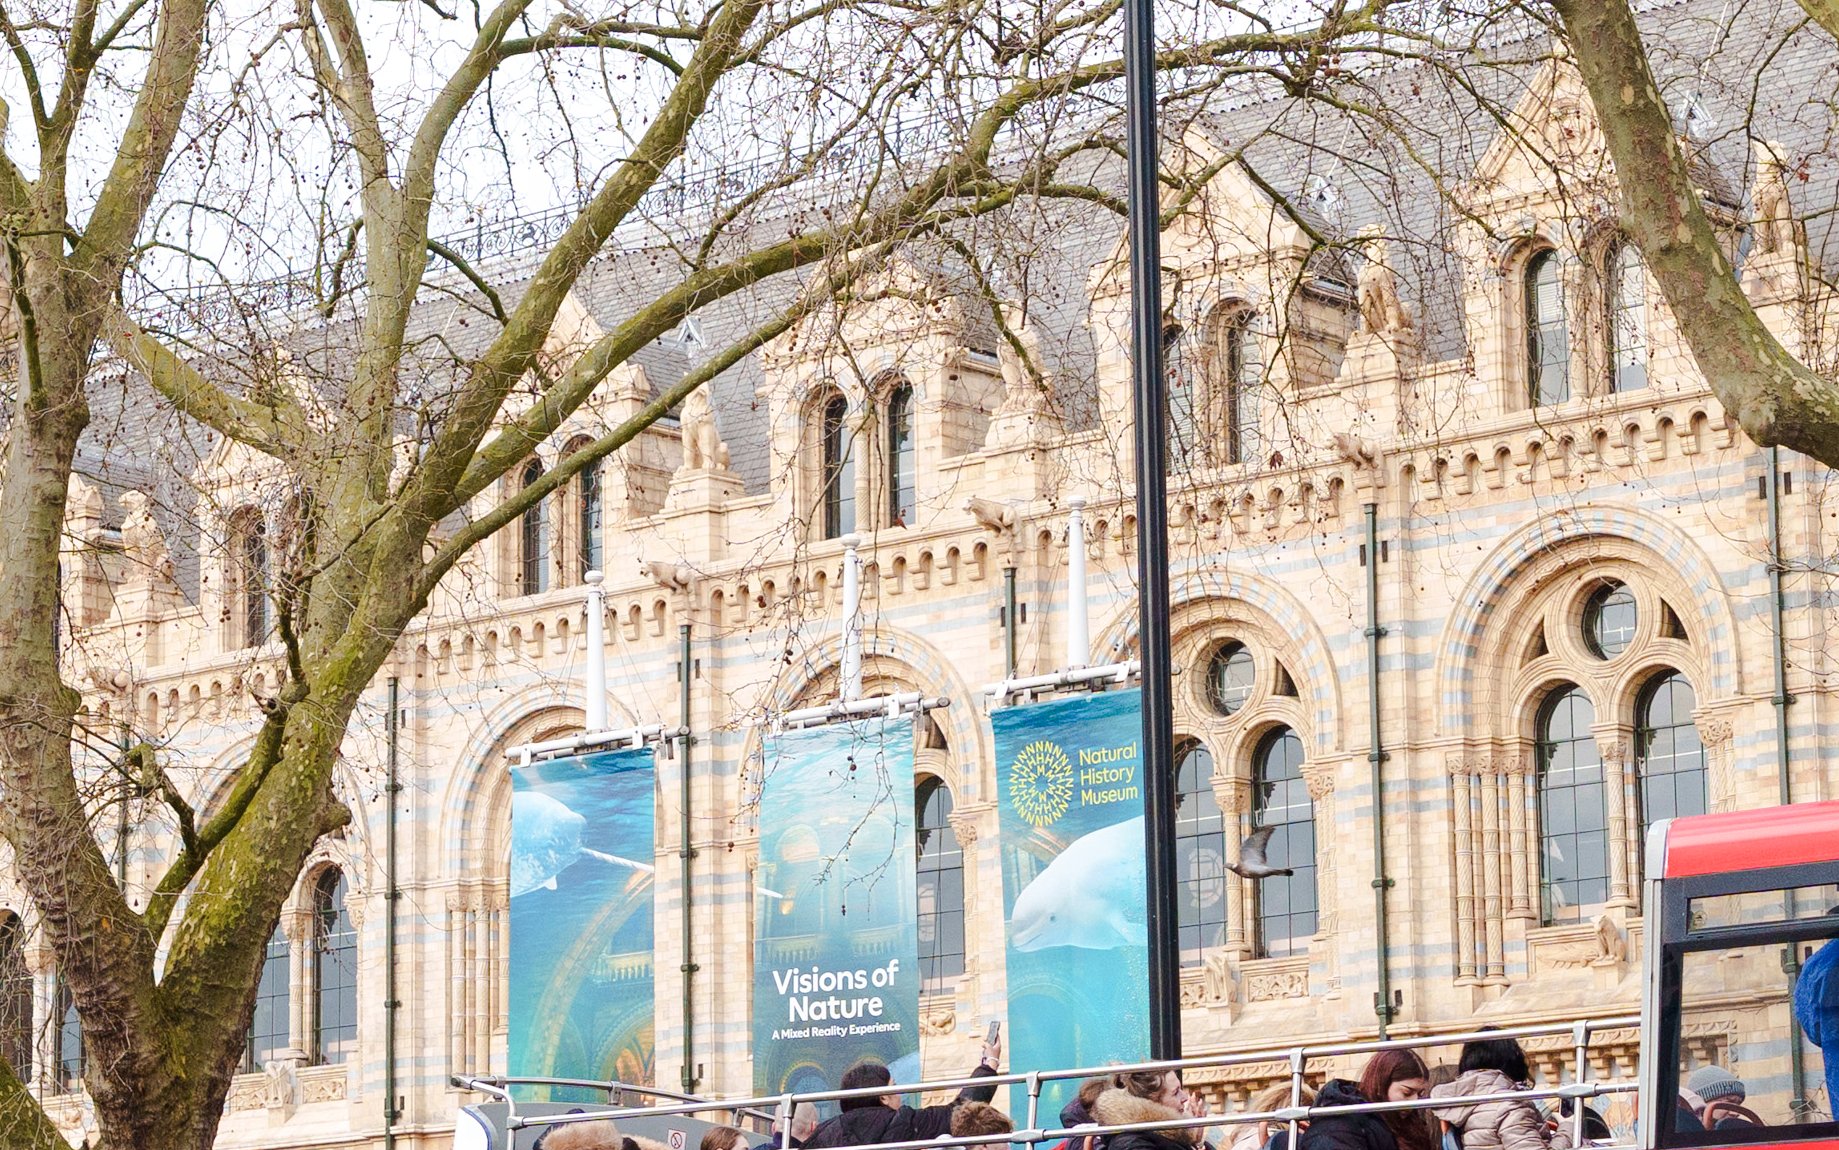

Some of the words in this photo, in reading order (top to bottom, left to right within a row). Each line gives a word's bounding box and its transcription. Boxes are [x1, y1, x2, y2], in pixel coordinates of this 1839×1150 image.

[1080, 741, 1137, 766] Natural
[1080, 766, 1135, 786] History
[1081, 786, 1138, 806] Museum
[772, 966, 868, 995] Visions
[871, 959, 899, 988] of
[789, 996, 883, 1022] Nature
[772, 1030, 780, 1040] A
[781, 1027, 810, 1040] Mixed
[812, 1025, 847, 1037] Reality
[849, 1022, 901, 1035] Experience
